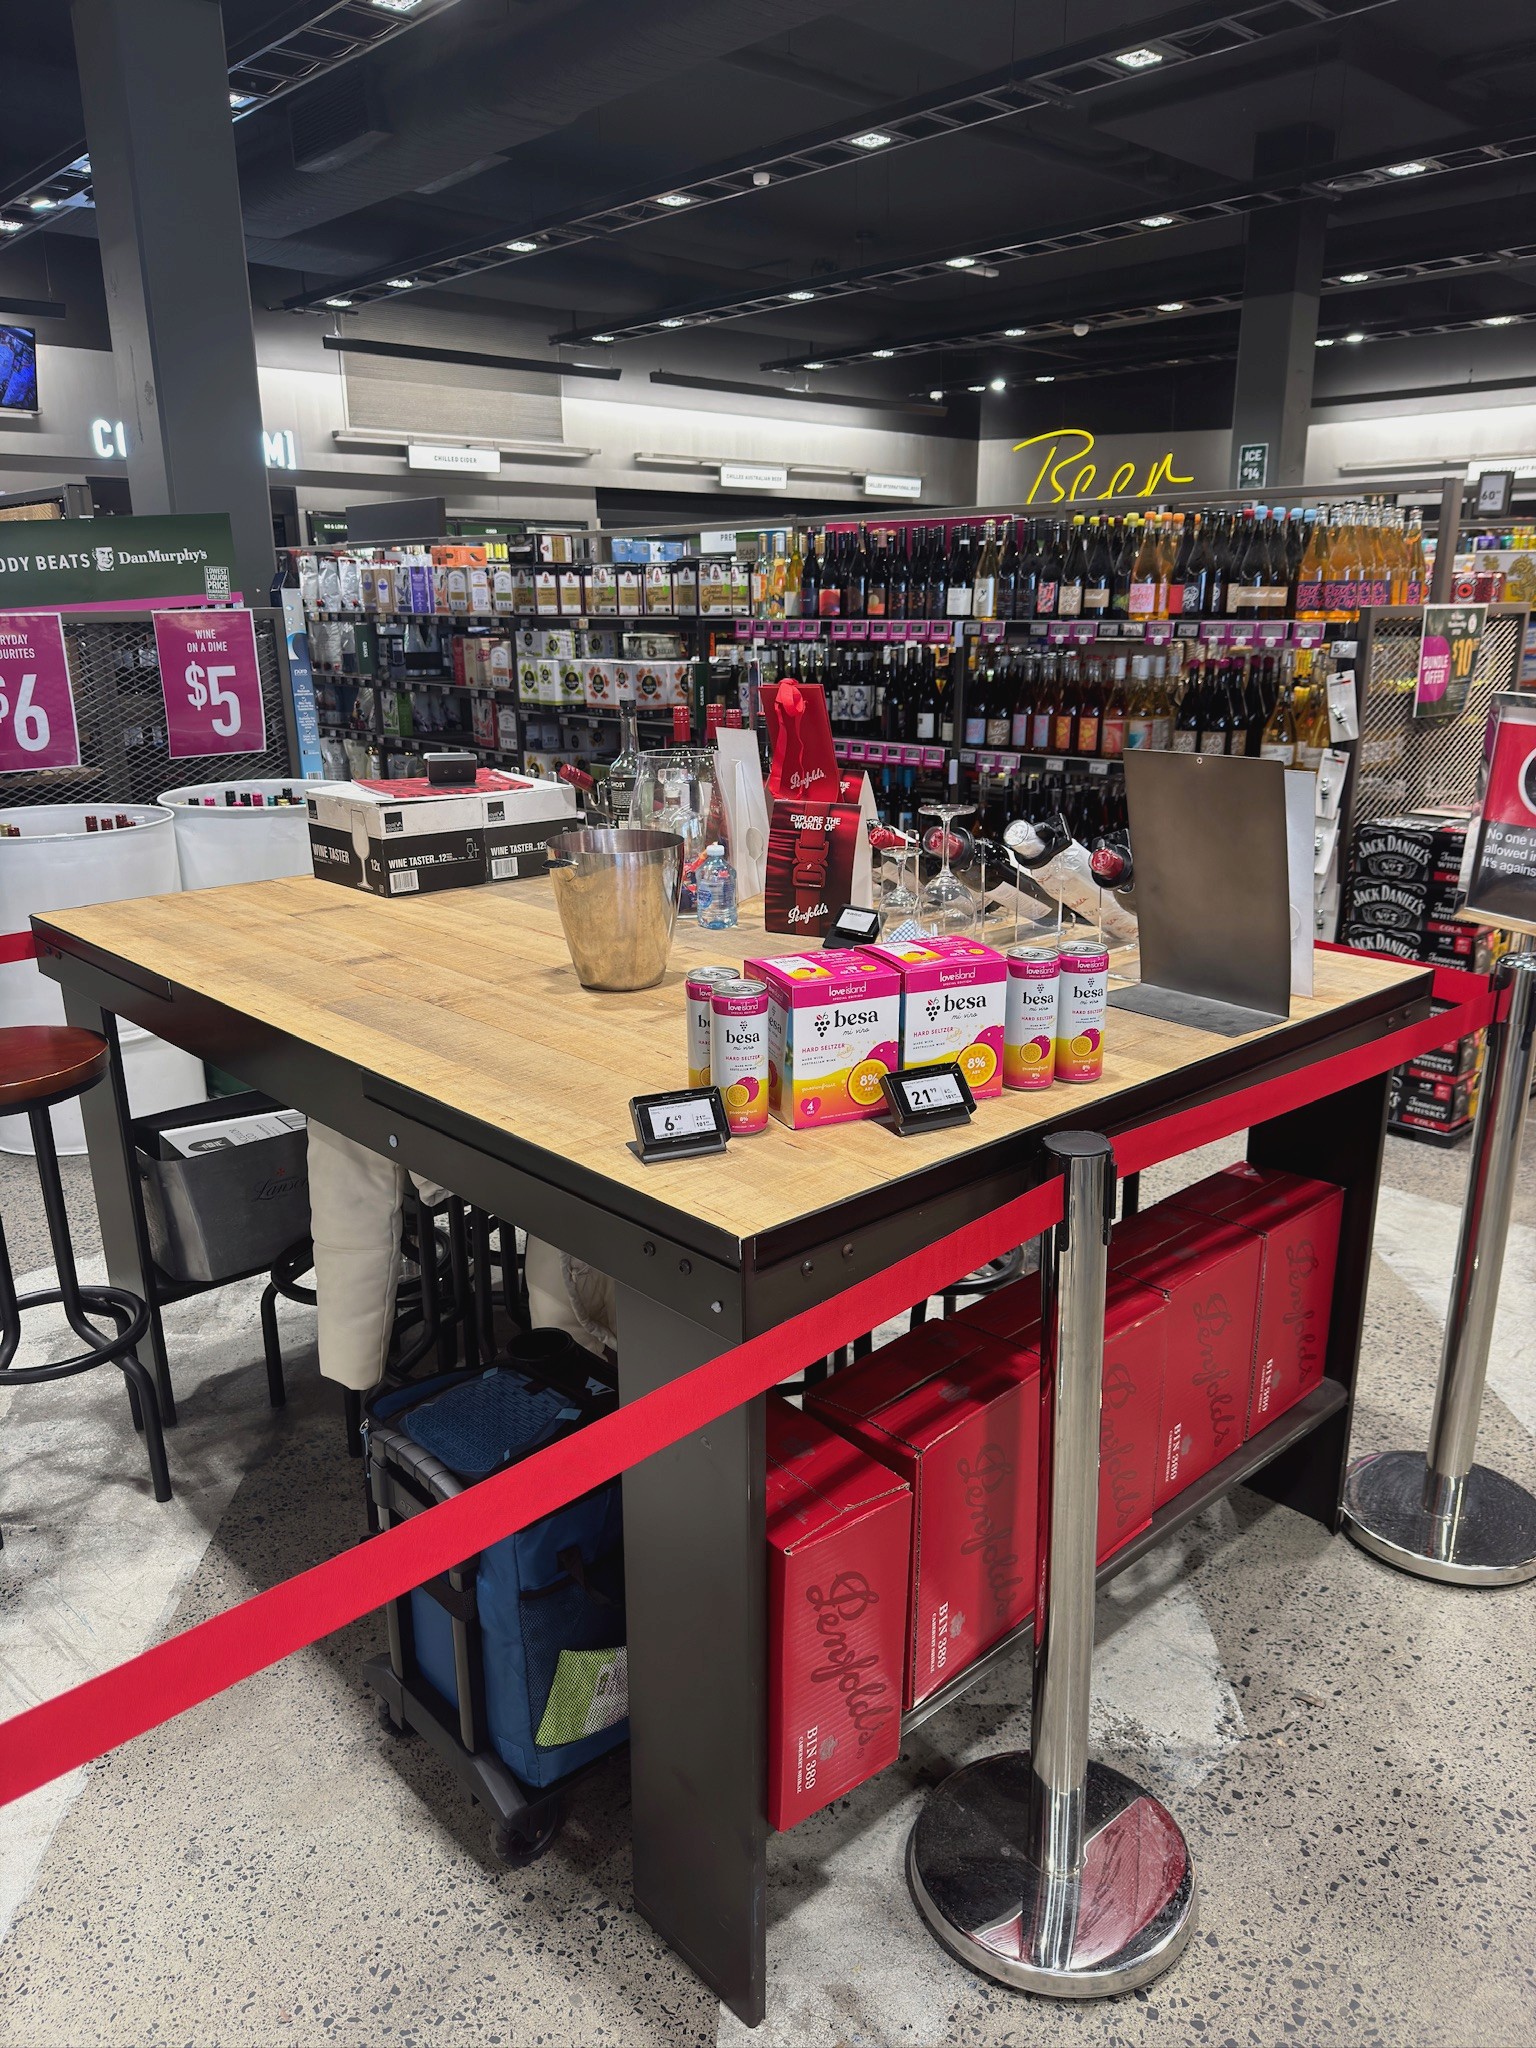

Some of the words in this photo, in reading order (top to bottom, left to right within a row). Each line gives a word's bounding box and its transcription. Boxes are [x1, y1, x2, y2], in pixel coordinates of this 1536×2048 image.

[1245, 449, 1262, 461] ICE
[35, 554, 91, 571] BEATS
[205, 567, 228, 575] LOWEST
[207, 581, 229, 591] PRICE
[195, 629, 217, 641] WINE
[187, 642, 200, 653] ON
[201, 642, 207, 652] A
[208, 641, 228, 652] DIME
[1423, 653, 1450, 670] BUNDLE
[1424, 669, 1446, 685] OFFER
[185, 661, 242, 737] $5
[790, 814, 824, 825] EXPLORE
[826, 816, 841, 825] THE
[794, 821, 822, 831] WORLD
[824, 823, 836, 831] OF
[1487, 828, 1503, 841] No
[1505, 834, 1527, 846] one
[312, 843, 329, 858] WINE
[328, 846, 350, 864] TASTER
[490, 845, 509, 857] WINE
[510, 843, 534, 854] TASTER
[1359, 837, 1386, 859] JACK
[1387, 834, 1432, 866] DANIEL'S
[1484, 844, 1529, 861] allowed
[370, 859, 382, 873] 12x
[388, 857, 409, 869] WINE
[409, 854, 435, 867] TASTER
[1481, 856, 1497, 869] It's
[1353, 886, 1380, 907] JACK
[1381, 885, 1426, 917] DANIEL'S
[787, 902, 829, 925] Penfolds
[1022, 992, 1054, 1005] besa
[1073, 986, 1104, 998] besa
[943, 994, 987, 1013] besa
[834, 1009, 879, 1028] besa
[726, 1029, 760, 1044] besa
[913, 1030, 930, 1038] HARD
[801, 1046, 820, 1054] HARD
[967, 1056, 986, 1069] 8%
[1412, 1058, 1455, 1073] WHISKEY
[860, 1073, 879, 1087] 8%
[911, 1089, 932, 1105] 21
[807, 1101, 814, 1111] 4
[1405, 1104, 1448, 1120] WHISKEY
[665, 1116, 675, 1131] 6
[1172, 1422, 1182, 1452] BIN
[938, 1601, 949, 1634] BIN
[805, 1570, 894, 1748] Penfolds
[937, 1635, 948, 1669] 389
[805, 1725, 819, 1761] BIN
[804, 1760, 818, 1791] 389
